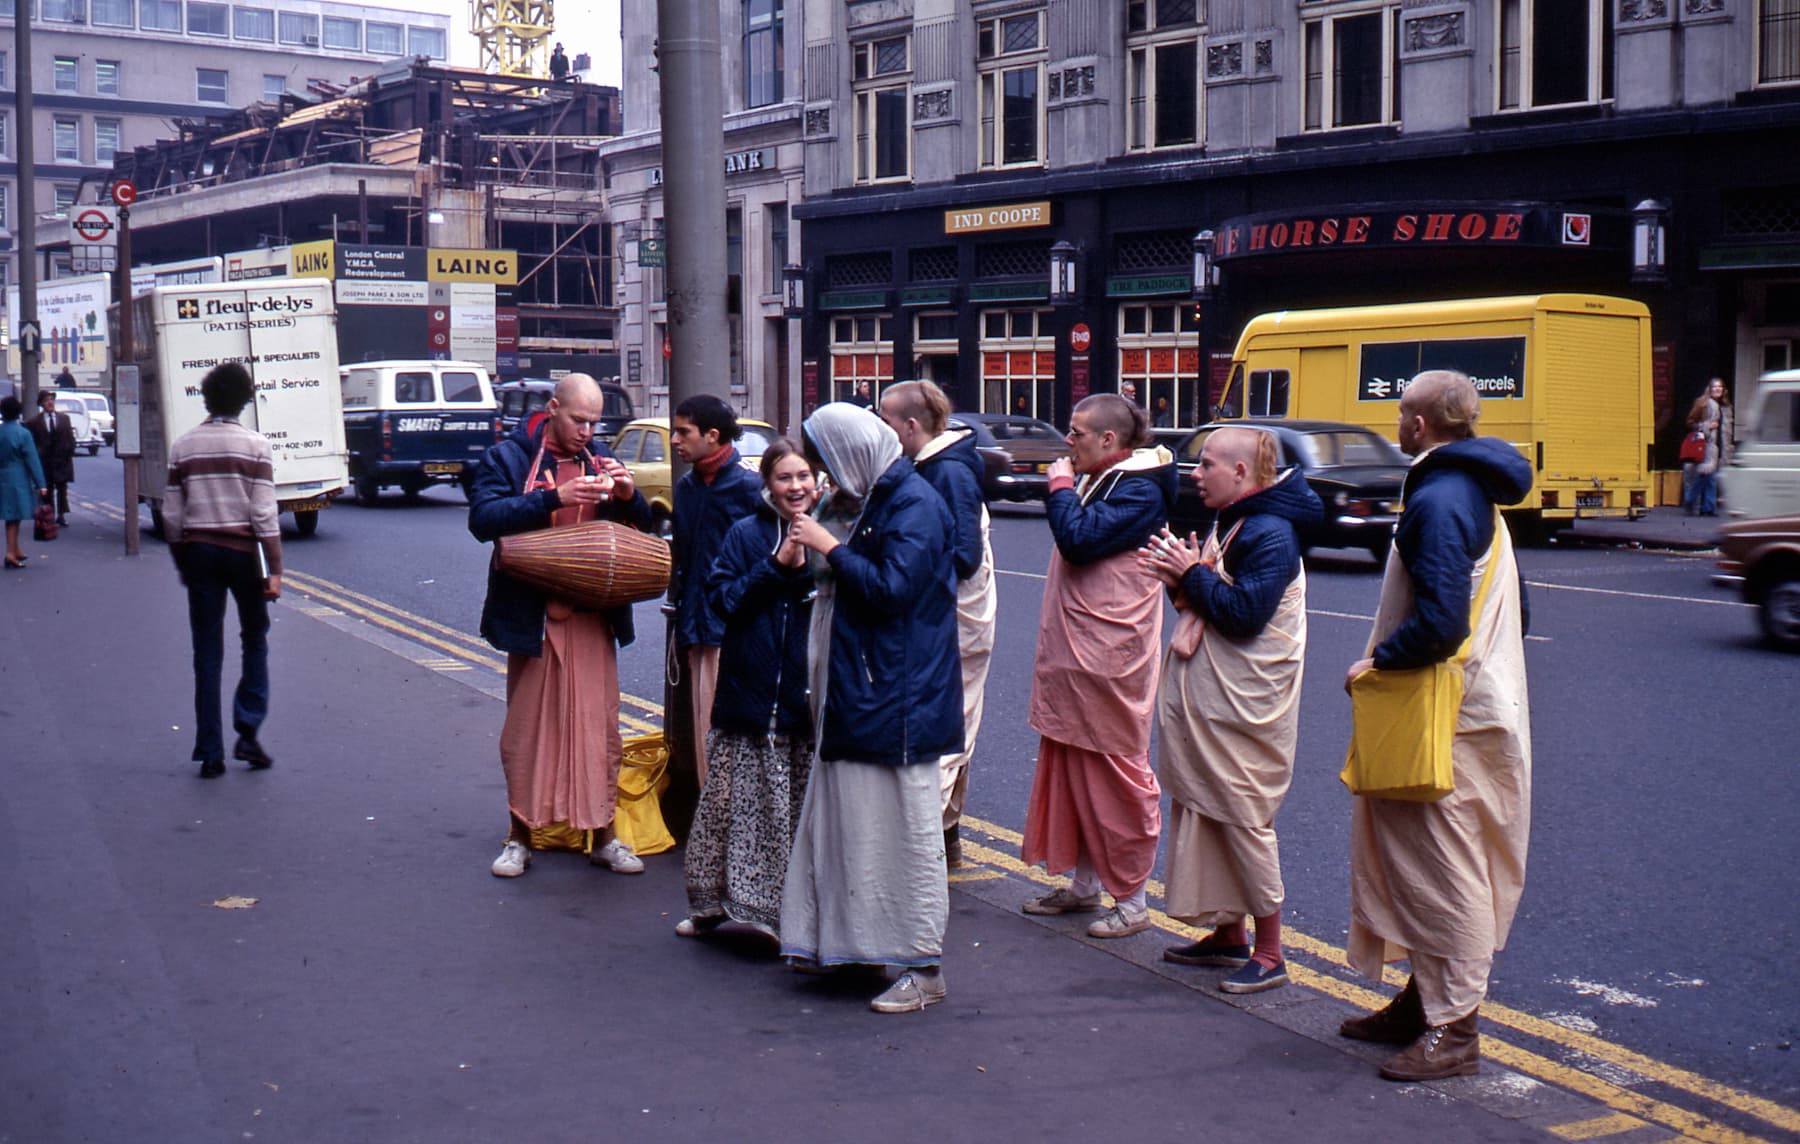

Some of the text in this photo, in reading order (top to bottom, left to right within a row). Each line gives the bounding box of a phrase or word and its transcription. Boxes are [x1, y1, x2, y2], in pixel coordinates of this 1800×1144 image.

[726, 151, 761, 172] ANK
[116, 184, 131, 202] C
[954, 207, 1041, 228] IND COOPE
[1215, 213, 1523, 256] HE HORSE SHOE
[296, 252, 329, 273] LAING
[344, 251, 404, 260] London Central
[345, 269, 406, 279] Redevelopment
[437, 258, 508, 275] LAING
[1112, 277, 1187, 291] THE PADDOCK
[203, 317, 296, 333] (PATISSERIES)
[182, 351, 320, 369] FRESH CREAM SPECIALISTS
[255, 377, 320, 391] etail Service
[398, 418, 442, 432] SMARTS
